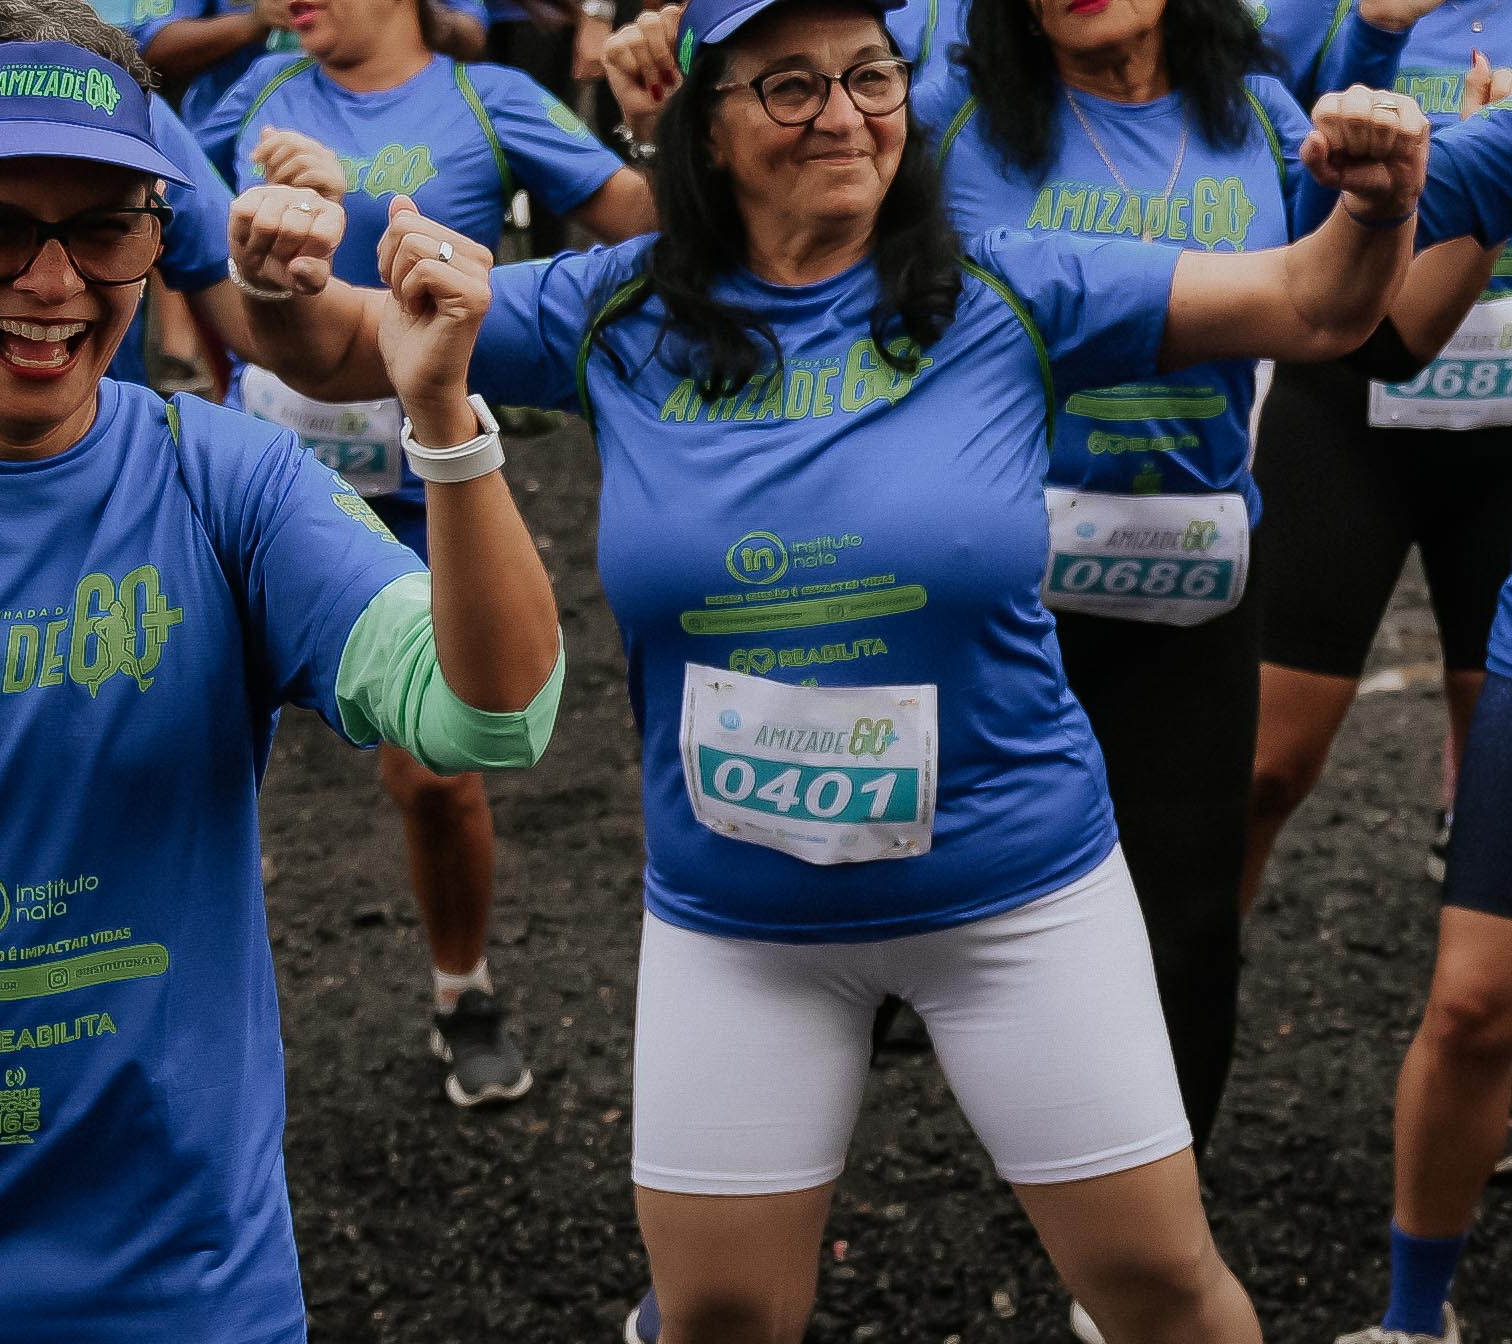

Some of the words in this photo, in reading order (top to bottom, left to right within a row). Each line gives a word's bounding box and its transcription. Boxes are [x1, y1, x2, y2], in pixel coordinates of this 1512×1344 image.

[85, 67, 122, 117] 60+
[1026, 187, 1190, 242] AMIZADE
[658, 366, 841, 424] AMIZADE
[1062, 558, 1220, 600] 0686
[69, 563, 184, 699] 60+
[753, 725, 848, 754] AMIZADE
[712, 760, 898, 819] 0401
[16, 873, 99, 903] instituto
[16, 899, 68, 923] nata
[20, 936, 89, 960] IMPACTAR
